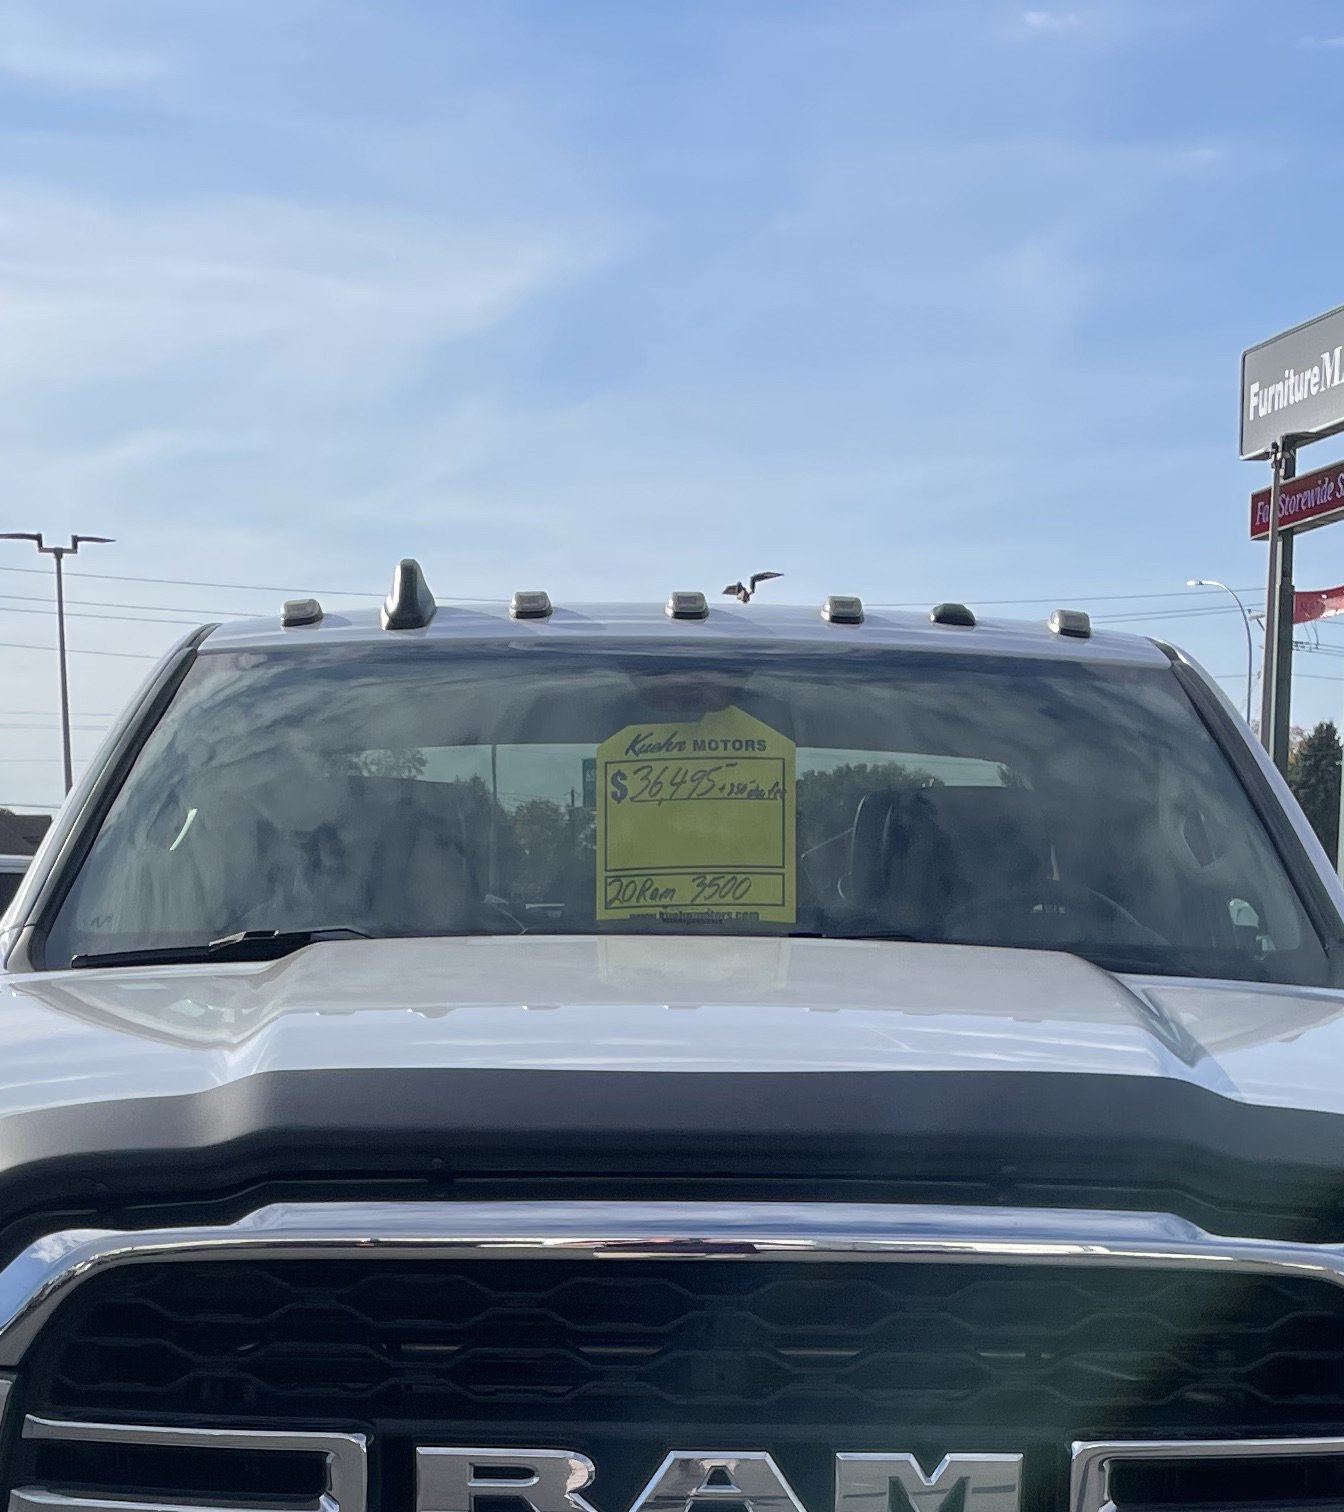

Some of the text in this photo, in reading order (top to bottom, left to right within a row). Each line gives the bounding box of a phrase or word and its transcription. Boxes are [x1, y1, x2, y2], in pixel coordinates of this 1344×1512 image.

[1278, 477, 1335, 518] Storewide
[625, 731, 767, 757] Kuehn MOTORS
[690, 875, 752, 904] 3500
